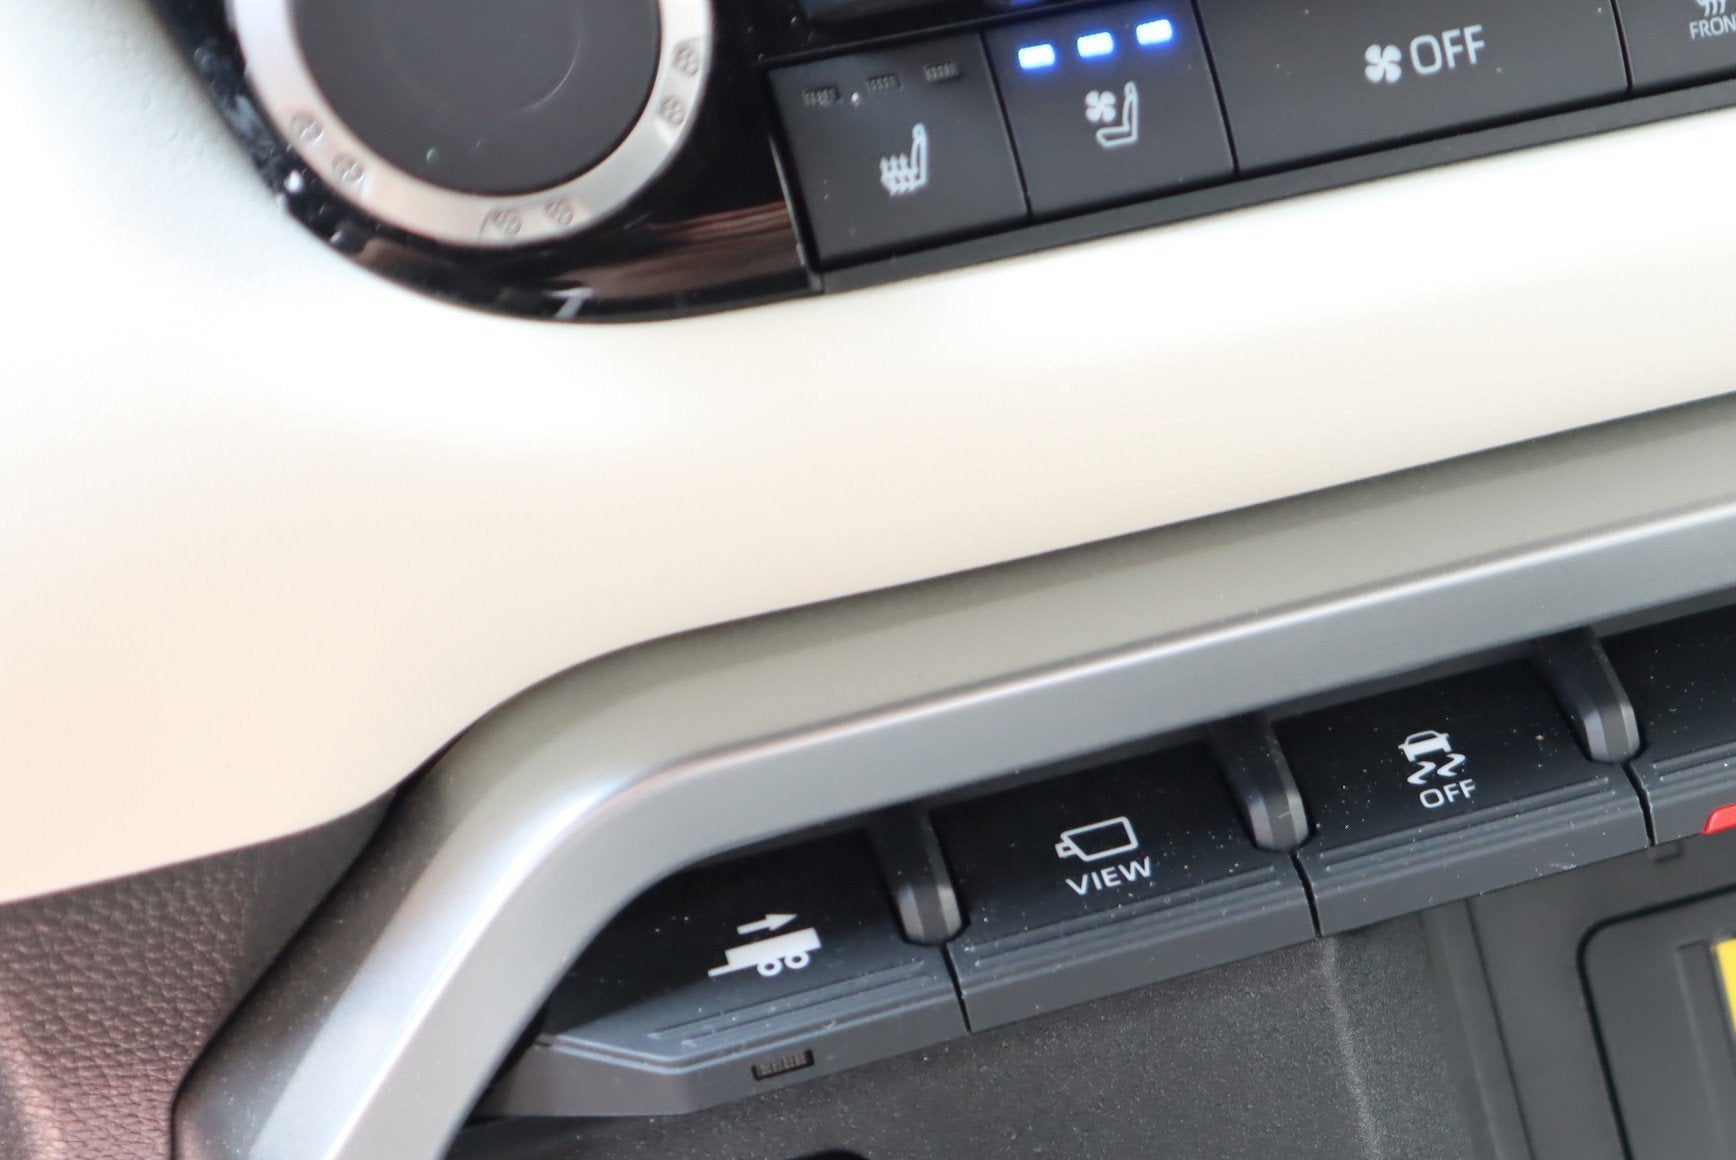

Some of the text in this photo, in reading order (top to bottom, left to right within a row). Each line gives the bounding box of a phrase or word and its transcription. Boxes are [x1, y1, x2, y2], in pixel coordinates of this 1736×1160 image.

[1410, 25, 1486, 76] OFF
[1419, 778, 1476, 808] OFF
[1065, 855, 1152, 895] VIEW
